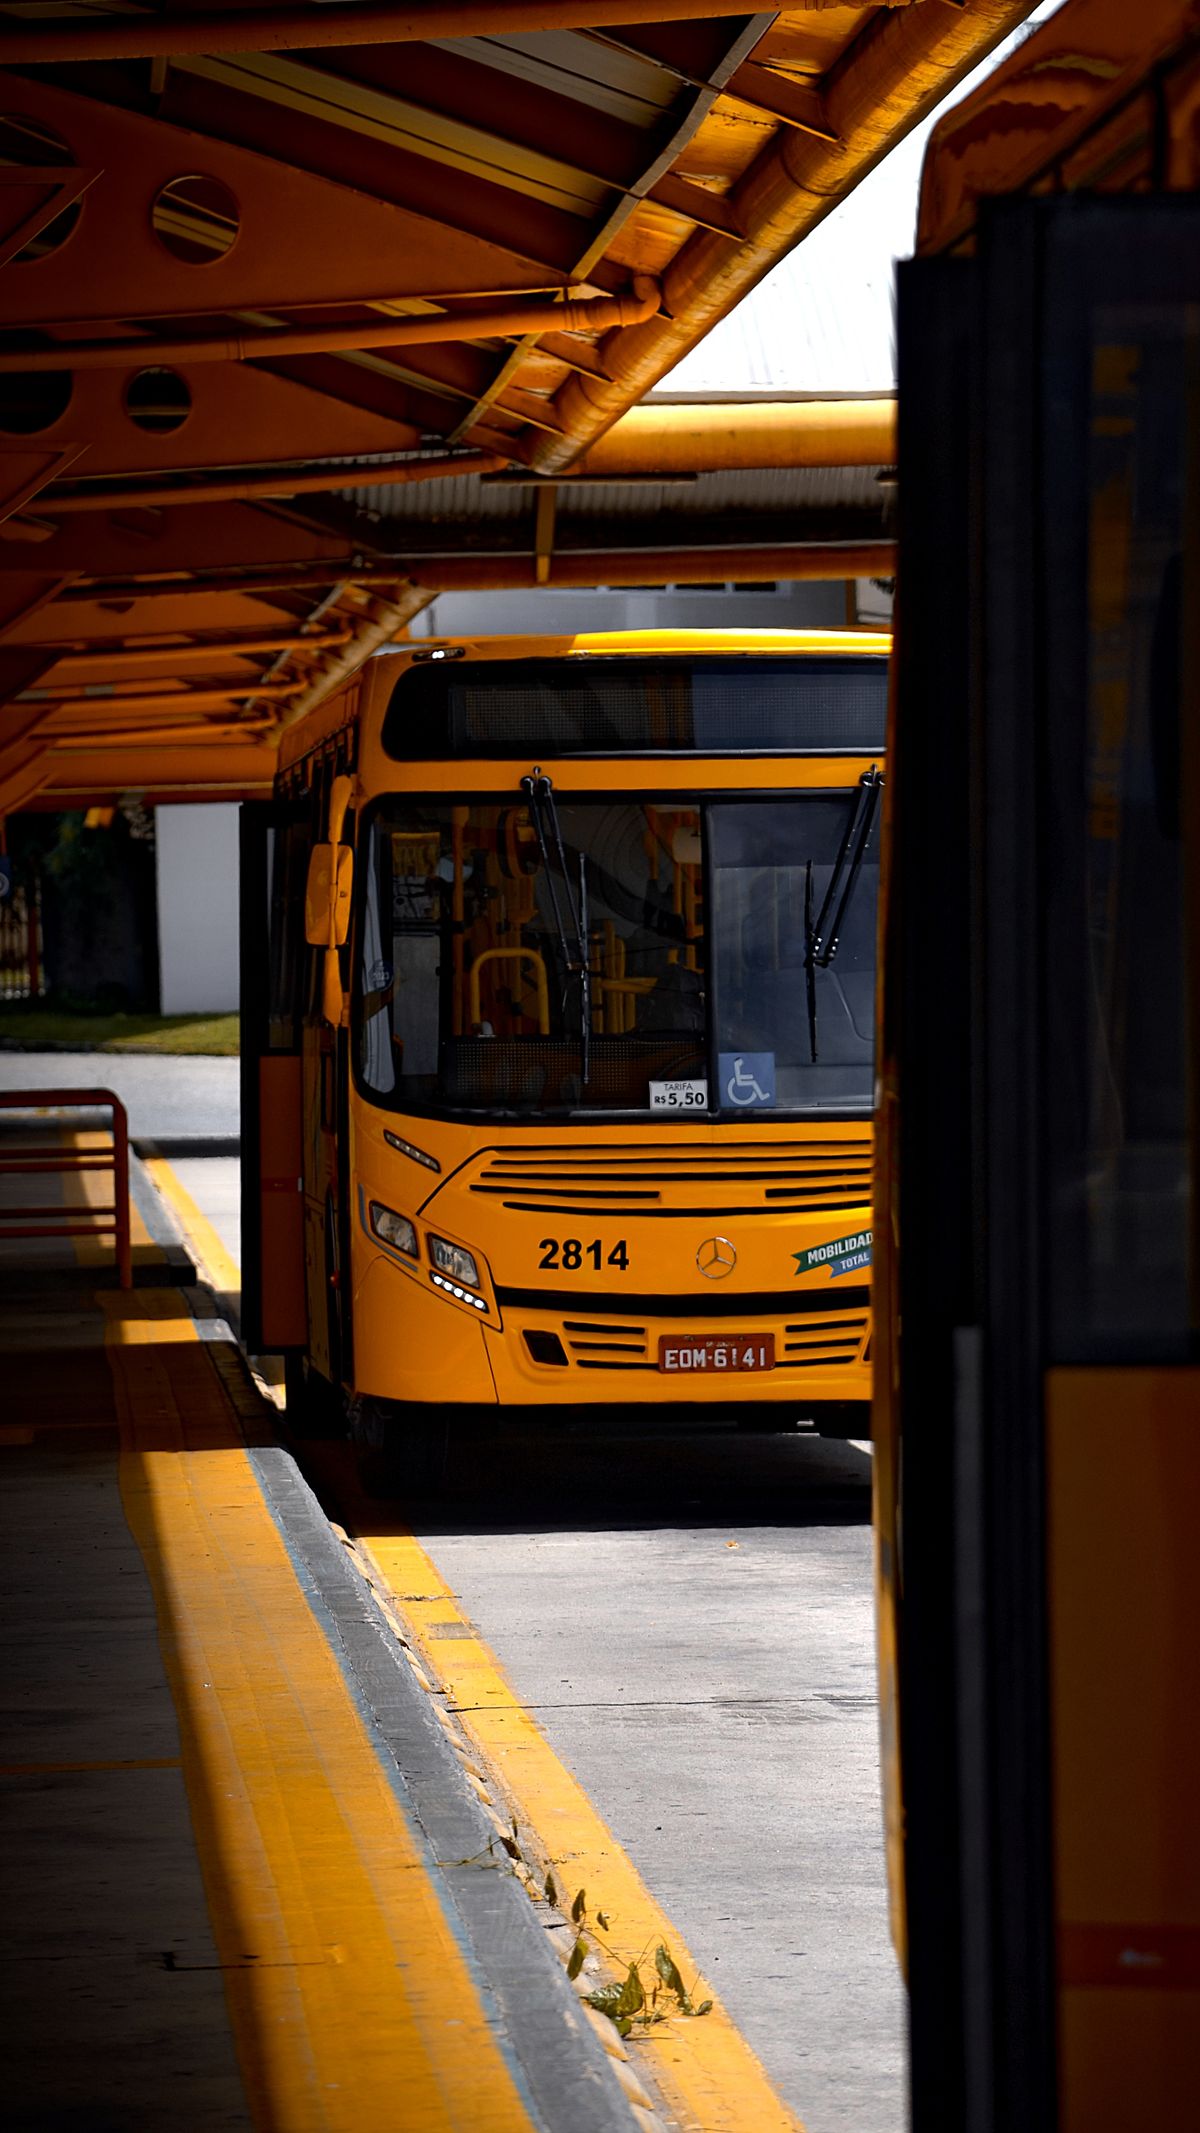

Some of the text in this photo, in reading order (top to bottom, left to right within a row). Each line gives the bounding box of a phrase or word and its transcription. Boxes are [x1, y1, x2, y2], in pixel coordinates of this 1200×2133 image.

[664, 1082, 693, 1091] TARIFA
[654, 1092, 705, 1107] R$ 5,50
[538, 1238, 630, 1271] 2814
[840, 1251, 870, 1270] TOTAL
